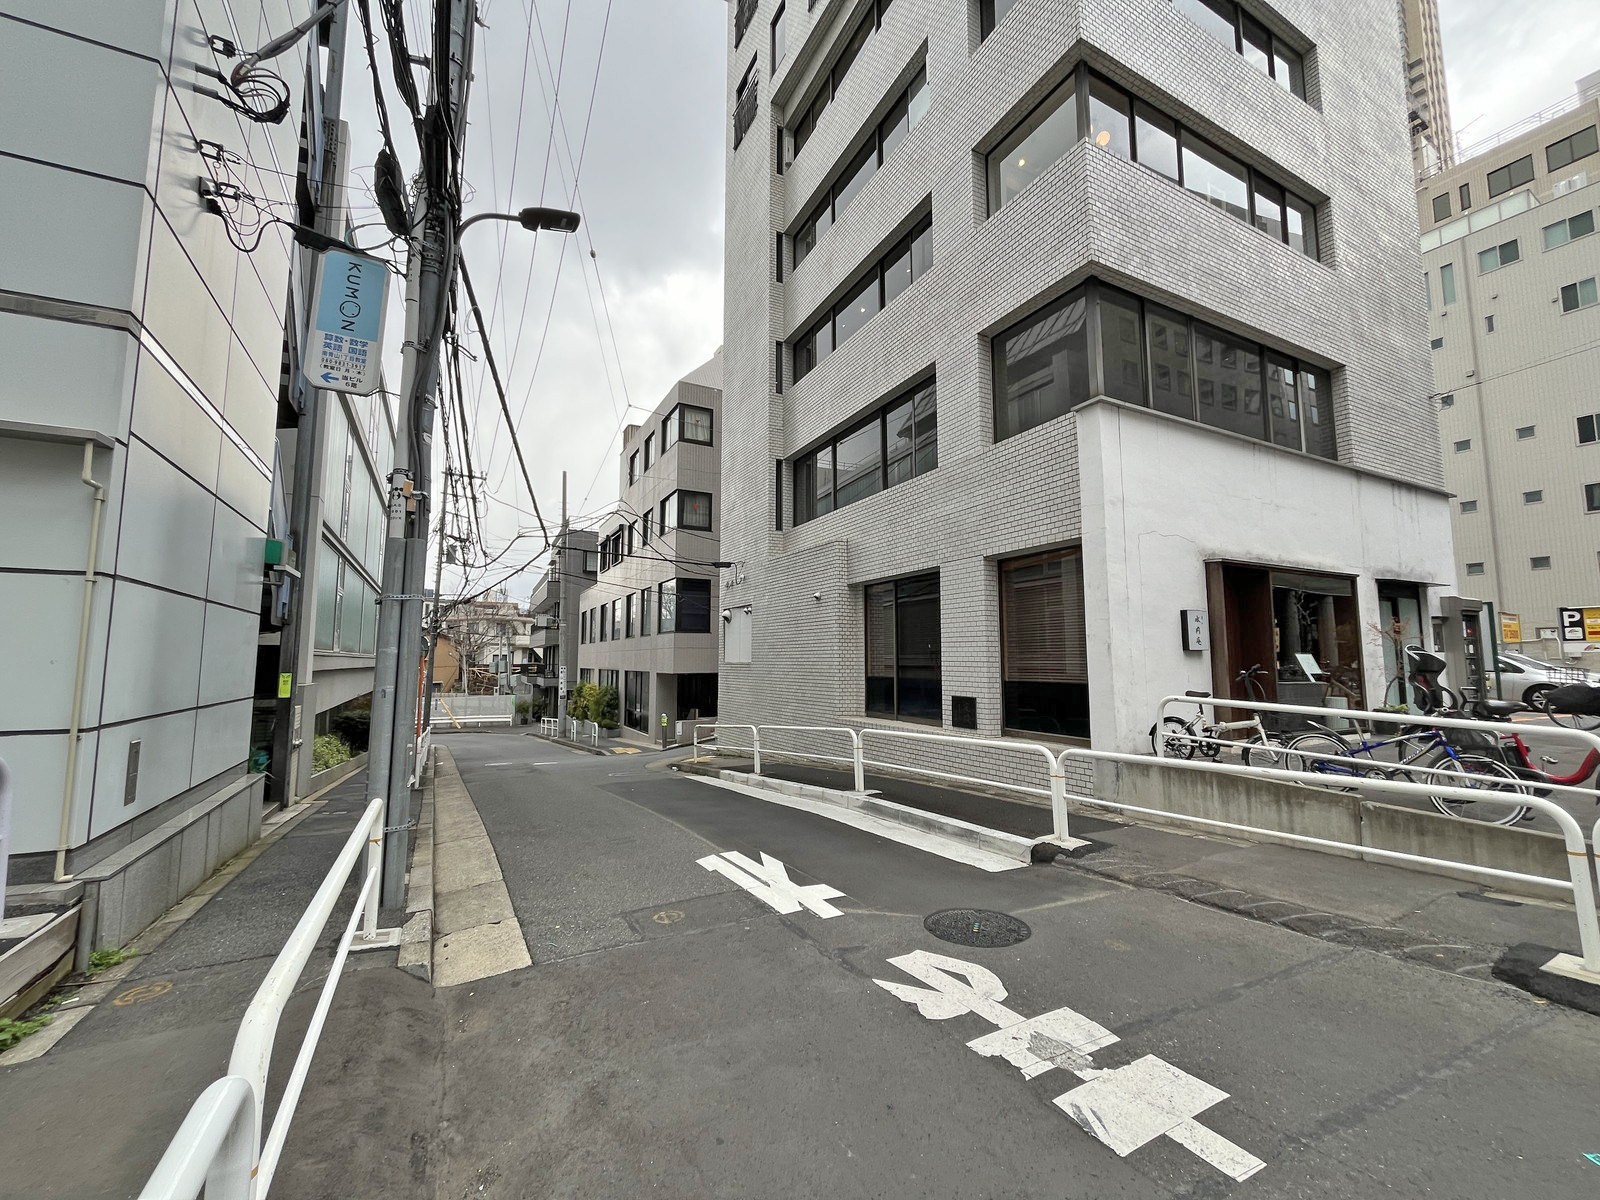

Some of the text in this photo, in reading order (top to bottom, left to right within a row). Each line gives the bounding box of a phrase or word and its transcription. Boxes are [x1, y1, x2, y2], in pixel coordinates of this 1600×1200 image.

[339, 261, 363, 333] KUMON
[324, 333, 369, 348] 算数・数学
[323, 341, 368, 357] 英語 国語
[1562, 611, 1581, 627] P
